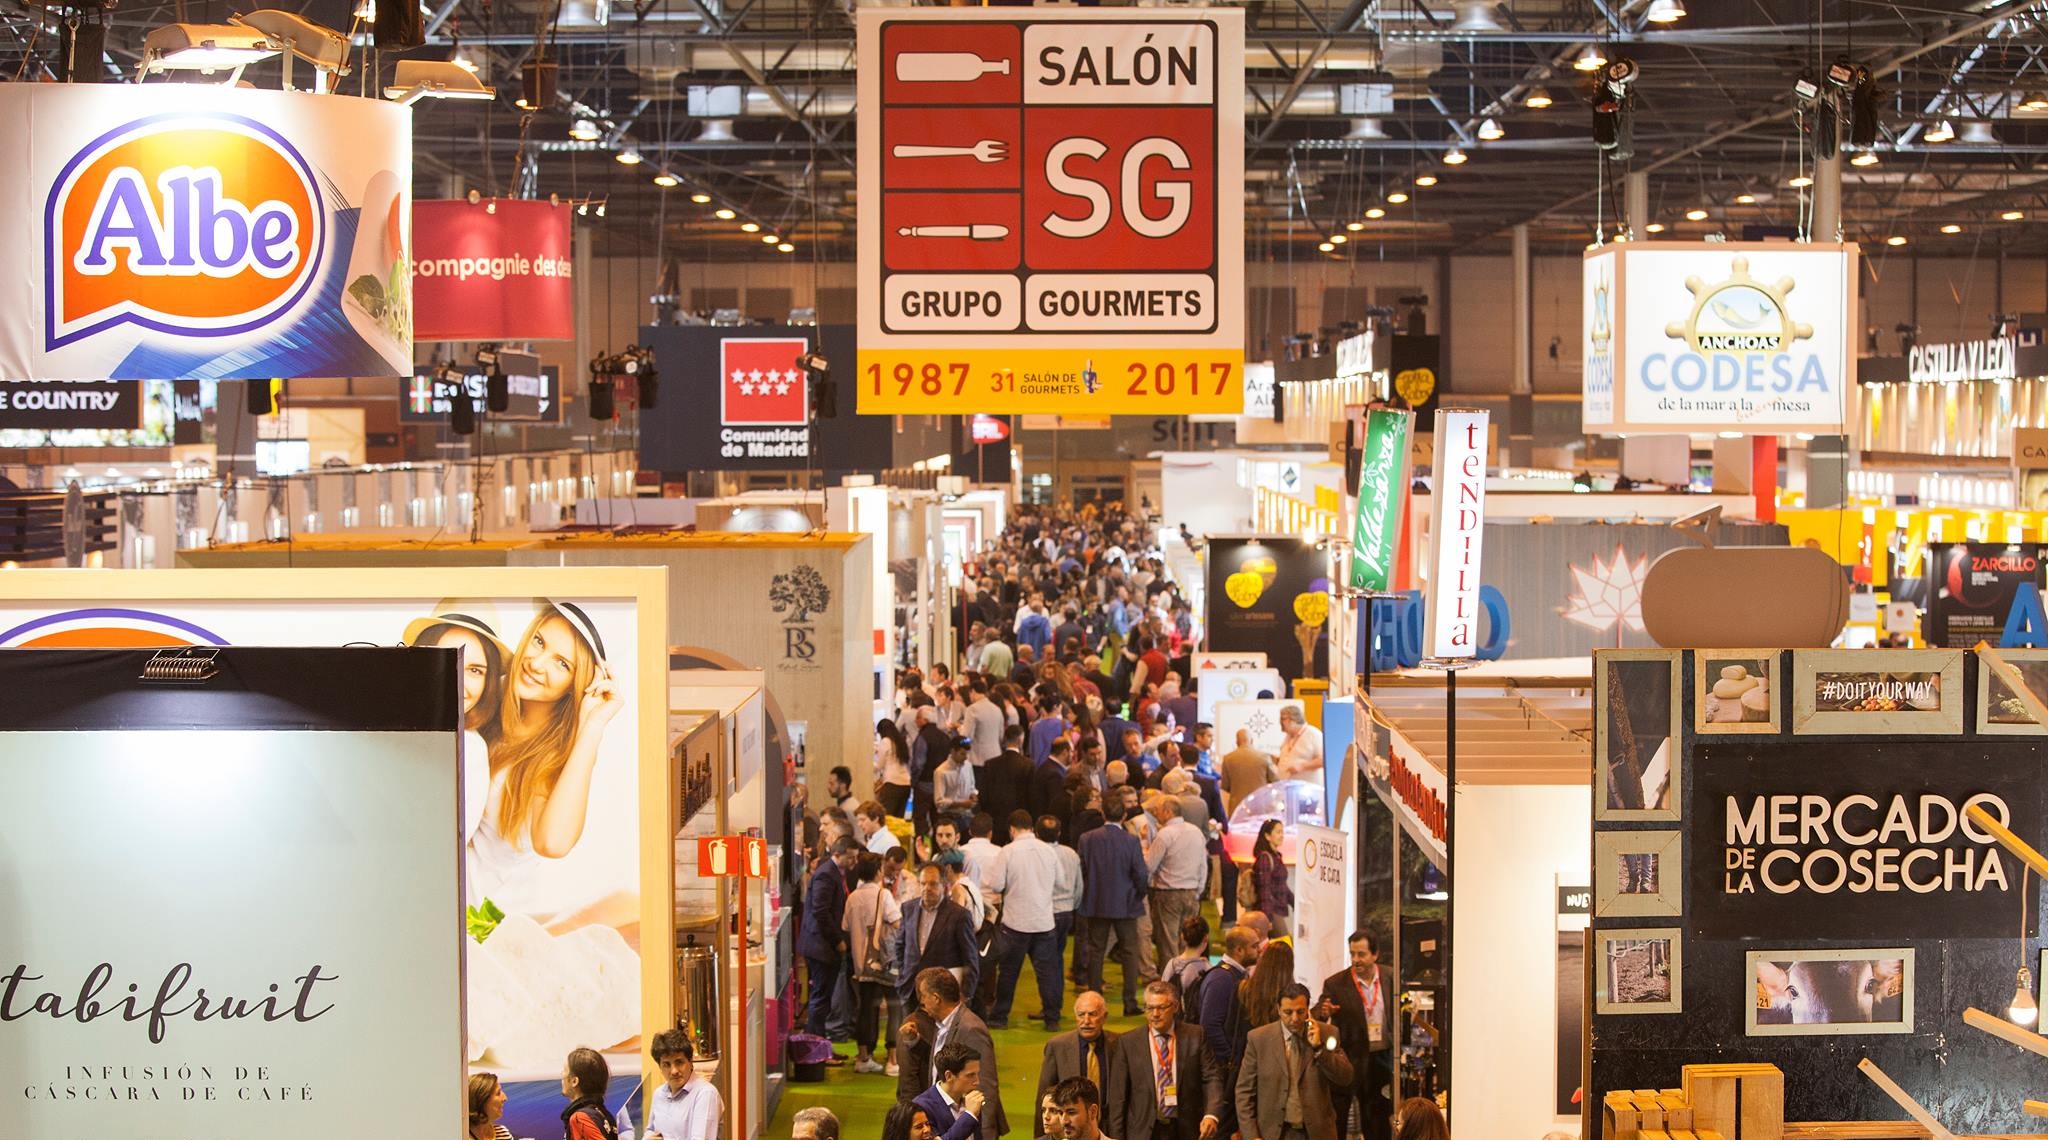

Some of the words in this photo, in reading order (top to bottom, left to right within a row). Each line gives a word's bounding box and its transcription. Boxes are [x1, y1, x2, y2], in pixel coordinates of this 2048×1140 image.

[1038, 33, 1198, 86] SALÓN
[1041, 136, 1192, 239] SG
[84, 176, 294, 267] Albe
[901, 290, 1002, 317] GRUPO
[1038, 290, 1202, 317] GOURMETS
[1700, 336, 1779, 350] ANCHOAS
[867, 363, 970, 397] 1987
[990, 372, 1015, 393] 31
[1023, 370, 1059, 383] SALÓN
[1063, 373, 1077, 383] DE
[1127, 363, 1232, 396] 2017
[1640, 352, 1830, 393] CODESA
[1020, 384, 1080, 394] GOURMETS
[12, 391, 120, 411] COUNTRY
[721, 428, 809, 443] Comunidad
[721, 443, 744, 457] de
[747, 442, 809, 457] Madrid
[1971, 556, 2036, 572] ZARCILLO
[1726, 793, 2011, 846] MERCADO
[1320, 841, 1343, 863] ESCUELA
[1725, 848, 1755, 870] DE
[1760, 848, 2009, 894] COSECHA
[1725, 872, 1755, 894] LA
[1566, 893, 1591, 908] NUE
[0, 962, 339, 1045] tabifruit
[66, 1062, 213, 1081] INFUSIÓN
[234, 1066, 270, 1081] DE
[24, 1083, 160, 1101] CÁSCARA
[182, 1087, 216, 1101] DE
[238, 1083, 314, 1101] CAFÉ
